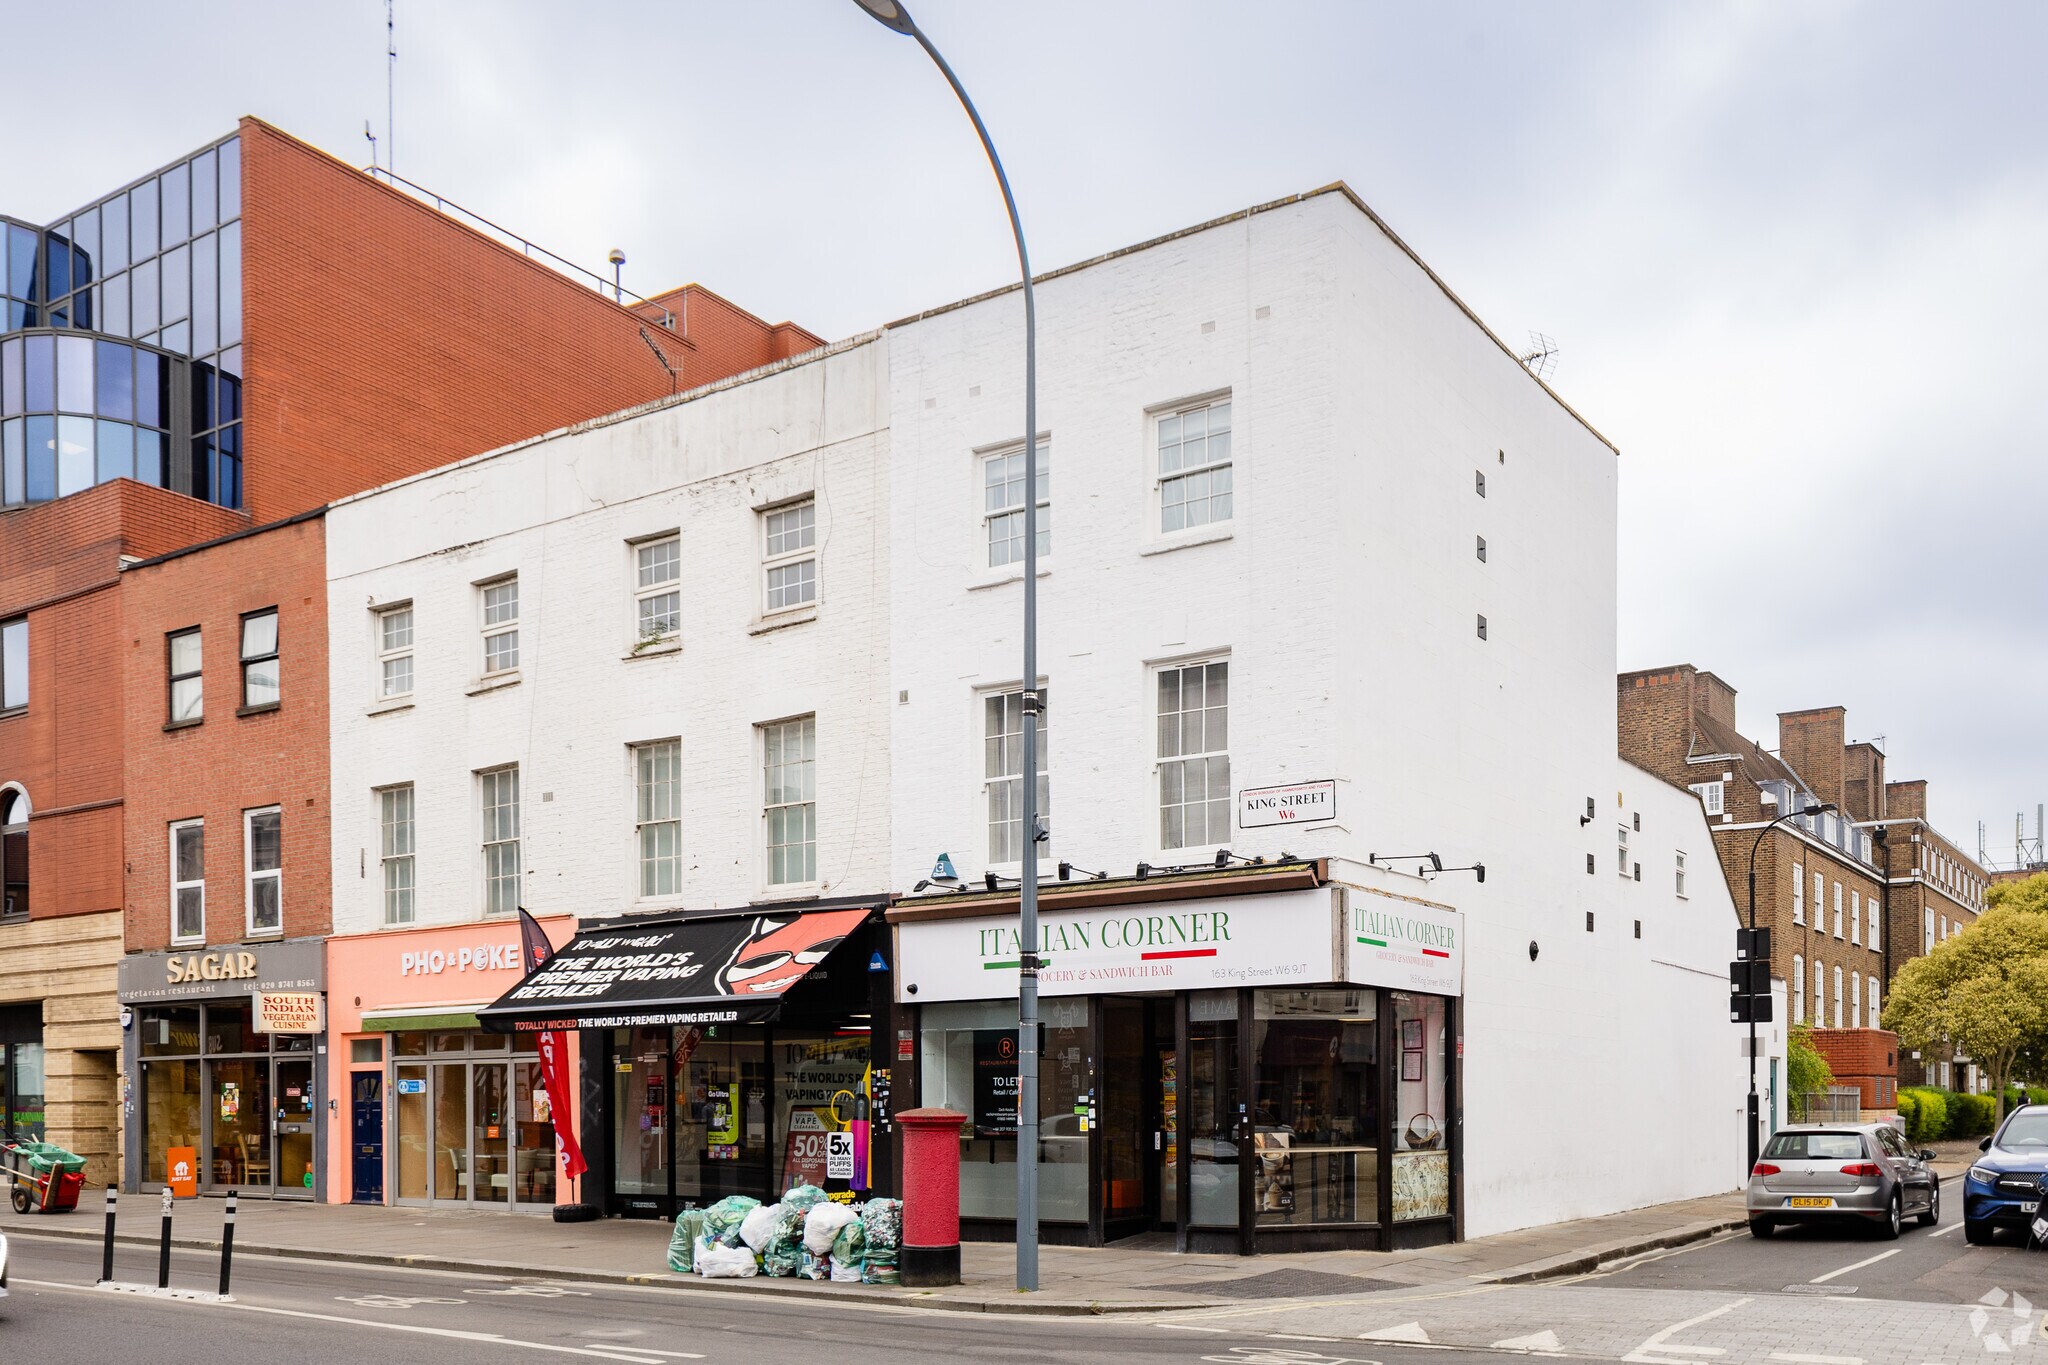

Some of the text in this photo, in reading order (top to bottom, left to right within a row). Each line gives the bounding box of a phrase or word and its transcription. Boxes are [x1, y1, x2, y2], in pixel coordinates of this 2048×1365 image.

[1247, 792, 1327, 810] KING STREET
[1279, 809, 1296, 820] W6
[1101, 911, 1232, 949] CORNER
[1355, 907, 1455, 949] ITALIAN CORNER
[166, 952, 258, 984] SAGAR
[401, 950, 445, 976] PHO
[447, 952, 456, 966] &
[548, 952, 695, 971] THE WORLD'S
[527, 964, 704, 985] PREMIER VAPING
[1036, 965, 1174, 983] ROCERY & SANDWICH BAR
[1211, 964, 1308, 981] 163 King Street W6 9JT
[120, 984, 215, 999] vegetarian restaurant
[243, 982, 259, 991] tel:
[261, 981, 275, 990] 020
[278, 980, 294, 989] 8741
[509, 983, 613, 1000] RETAILER
[263, 996, 315, 1005] SOUTH
[263, 1004, 315, 1013] INDIAN
[262, 1013, 317, 1022] VEGETARIAN
[272, 1021, 307, 1029] CUISINE
[514, 1011, 738, 1031] TOTALLY WICKED THE WORLD'S PREMIER VAPING RETAILER
[785, 1072, 806, 1083] THE
[808, 1072, 855, 1083] WORLD'S
[992, 1076, 1019, 1087] TO LET
[785, 1089, 824, 1101] VAPING
[793, 1135, 827, 1157] 50%
[829, 1135, 851, 1156] 5x
[1794, 1198, 1830, 1206] GL15 DKJ
[2024, 1203, 2040, 1211] LP
